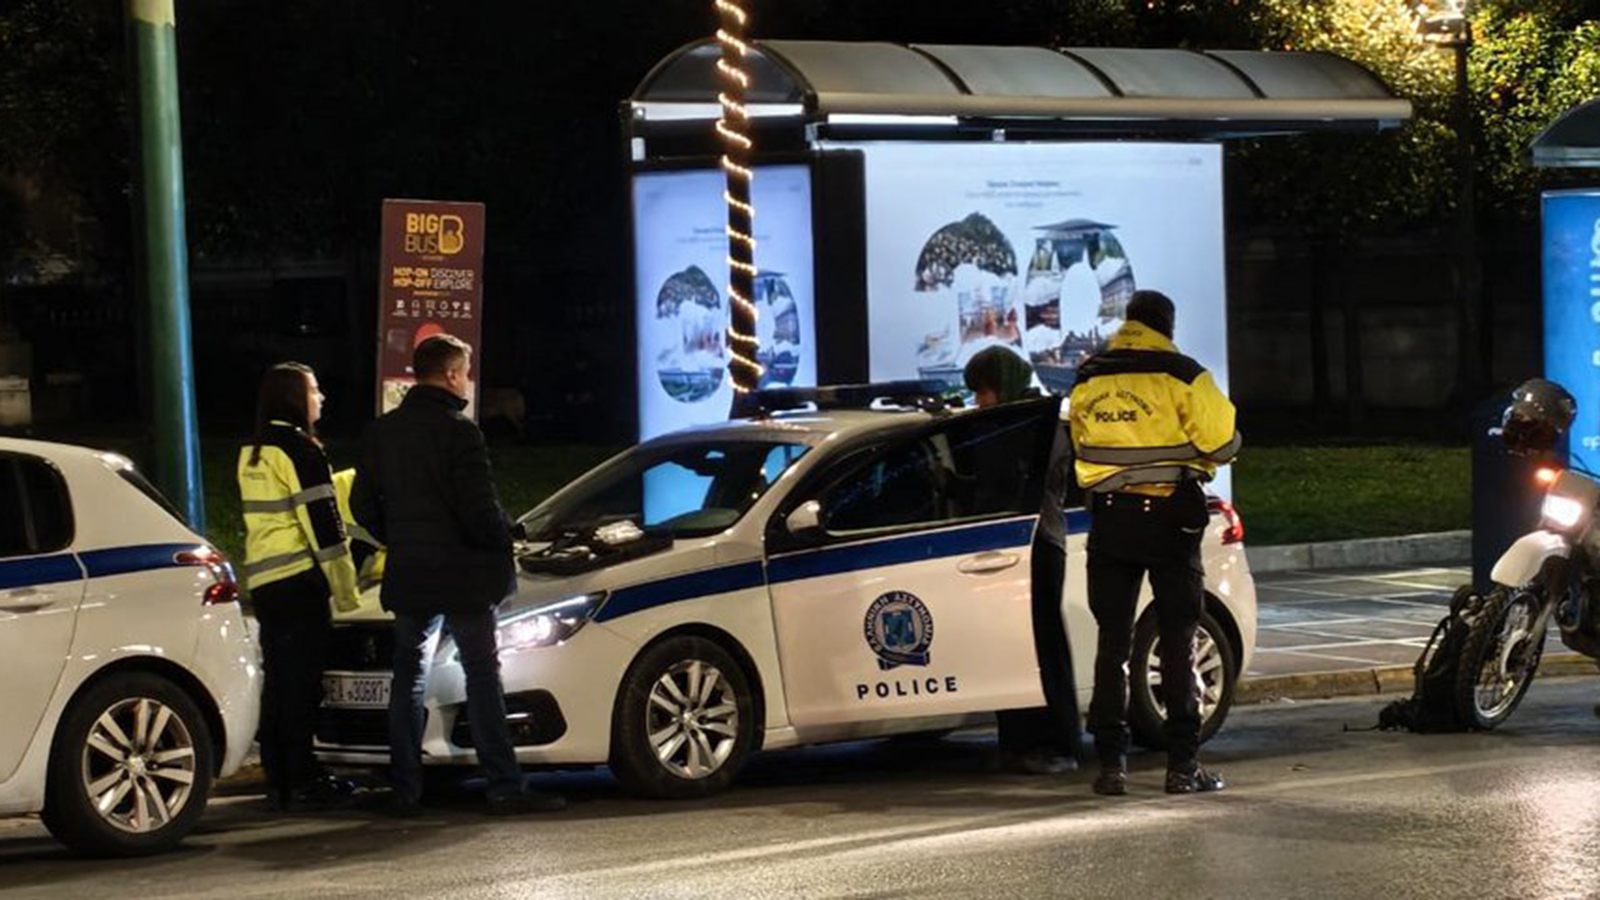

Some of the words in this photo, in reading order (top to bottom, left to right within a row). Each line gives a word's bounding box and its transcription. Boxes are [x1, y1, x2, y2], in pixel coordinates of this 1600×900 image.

[406, 213, 440, 234] BIG
[404, 234, 438, 254] BUS
[393, 267, 429, 278] HOP-ON
[430, 268, 474, 280] DISCOVER
[392, 277, 432, 289] HOP-OFF
[433, 279, 474, 291] EXPLORE
[1095, 409, 1138, 423] POLICE
[857, 676, 958, 700] POLICE
